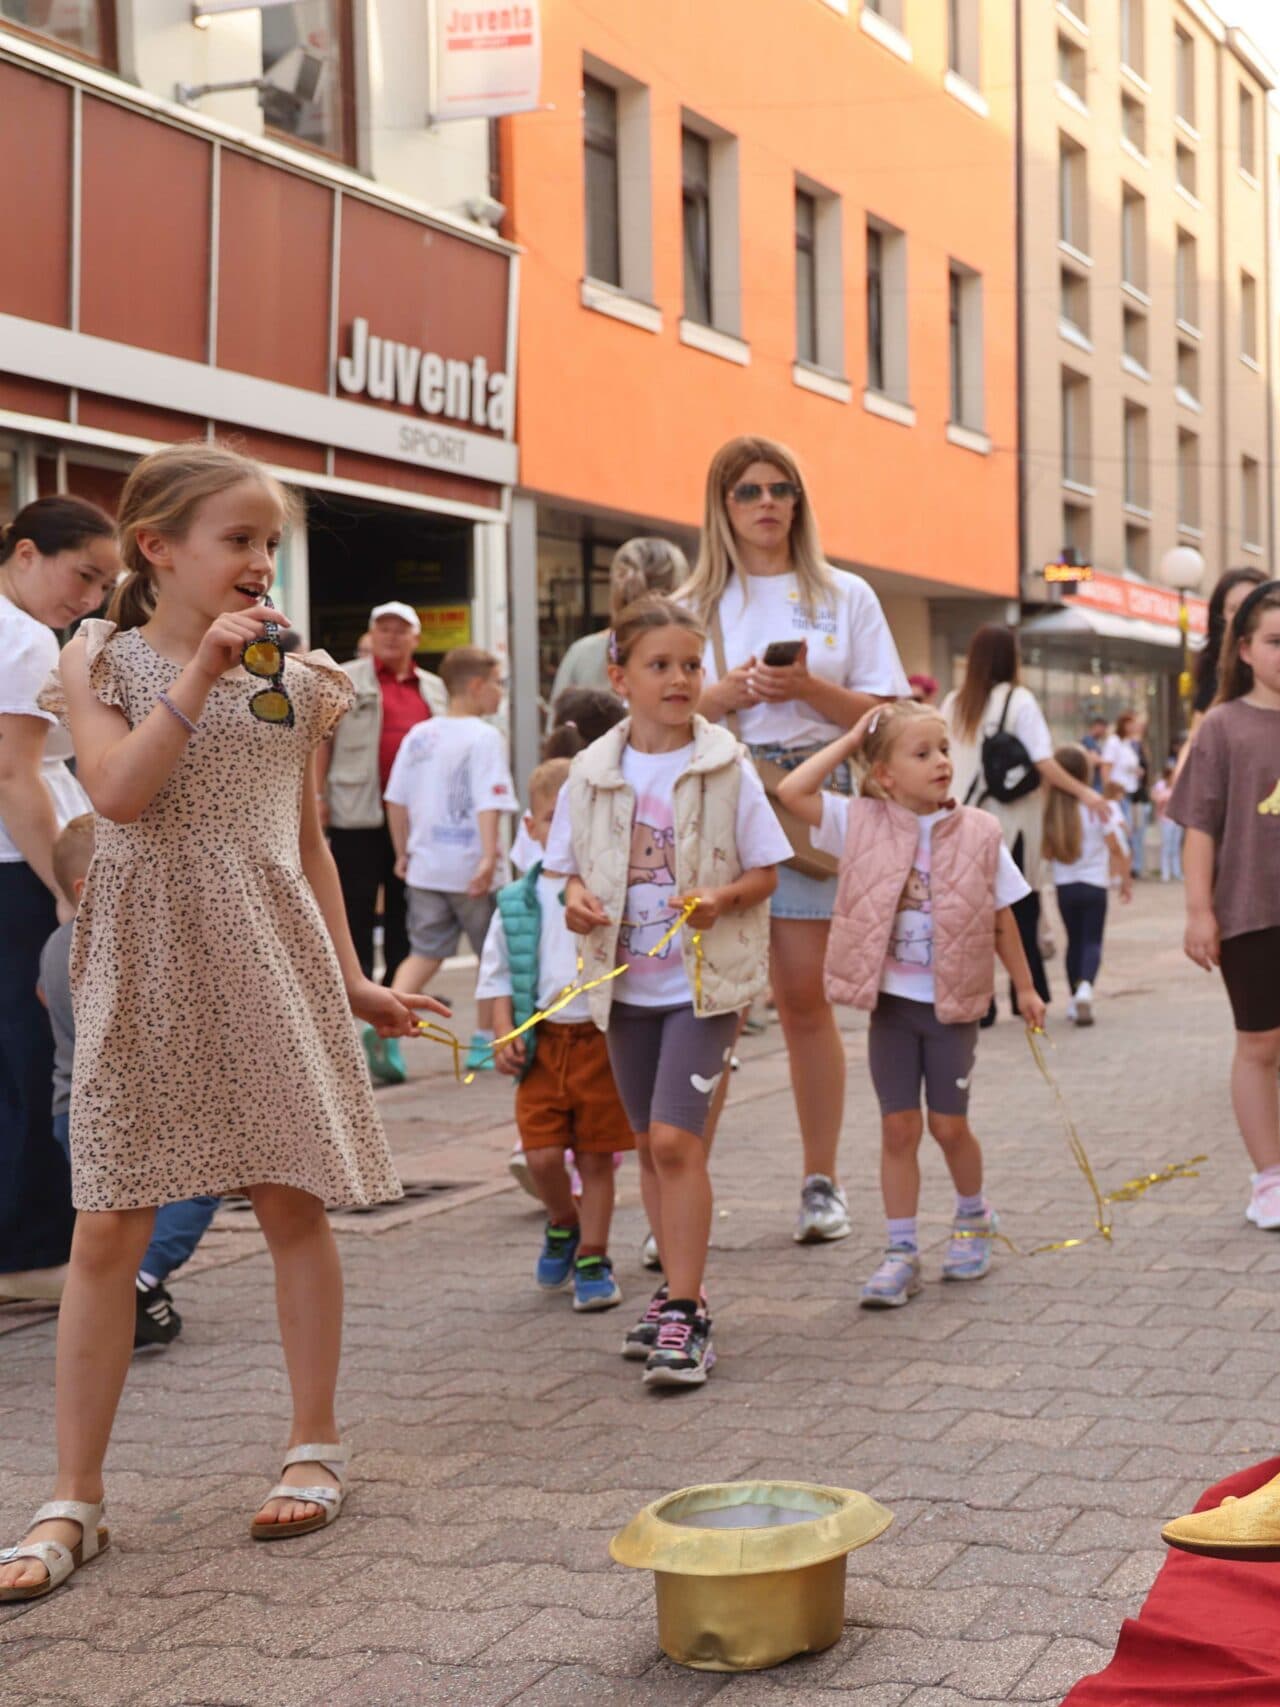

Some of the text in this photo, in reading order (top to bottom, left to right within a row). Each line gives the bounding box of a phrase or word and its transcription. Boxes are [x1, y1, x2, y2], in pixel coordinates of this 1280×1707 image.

[447, 6, 532, 32] Juventa
[339, 316, 508, 431] Juventa
[400, 426, 466, 464] SPORT
